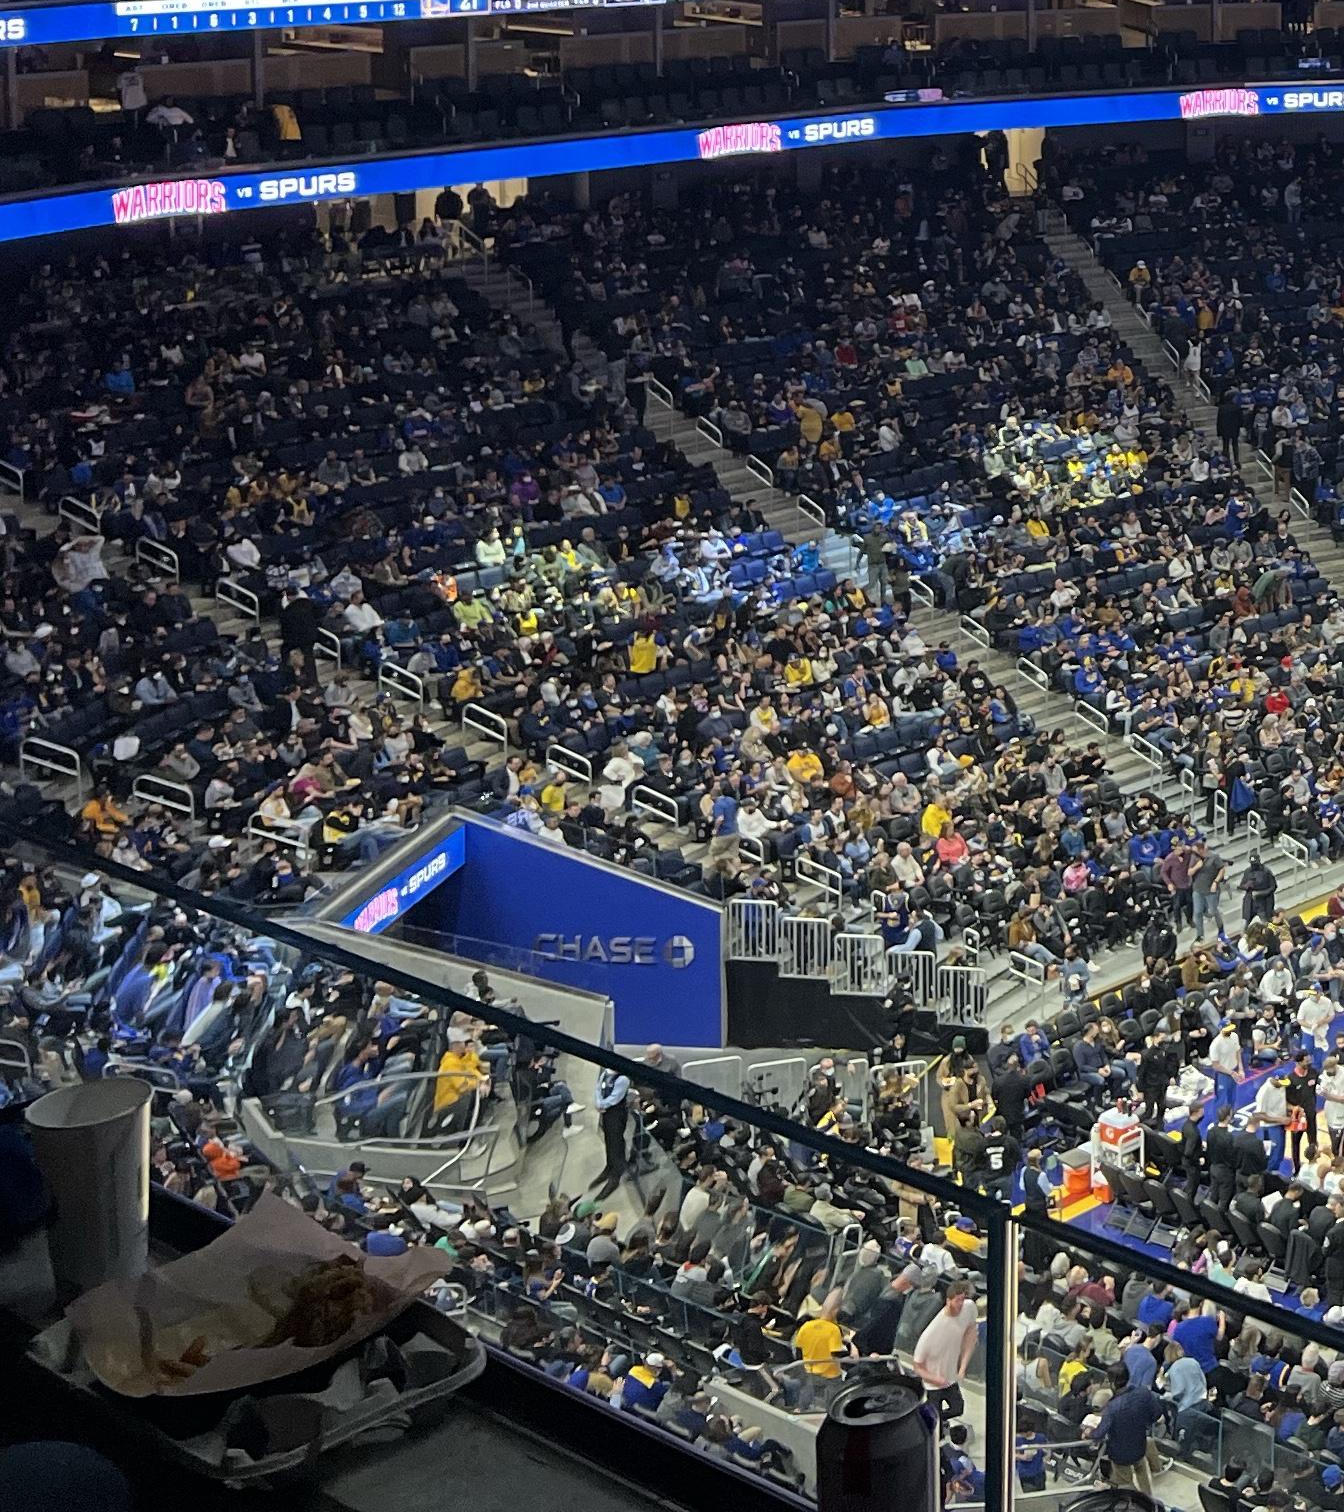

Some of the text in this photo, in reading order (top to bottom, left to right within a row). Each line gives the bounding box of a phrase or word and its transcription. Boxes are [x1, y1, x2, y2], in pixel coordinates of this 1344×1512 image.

[1179, 88, 1260, 119] WARRIORS
[112, 178, 227, 224] WARRIORS
[258, 171, 356, 201] SPURS
